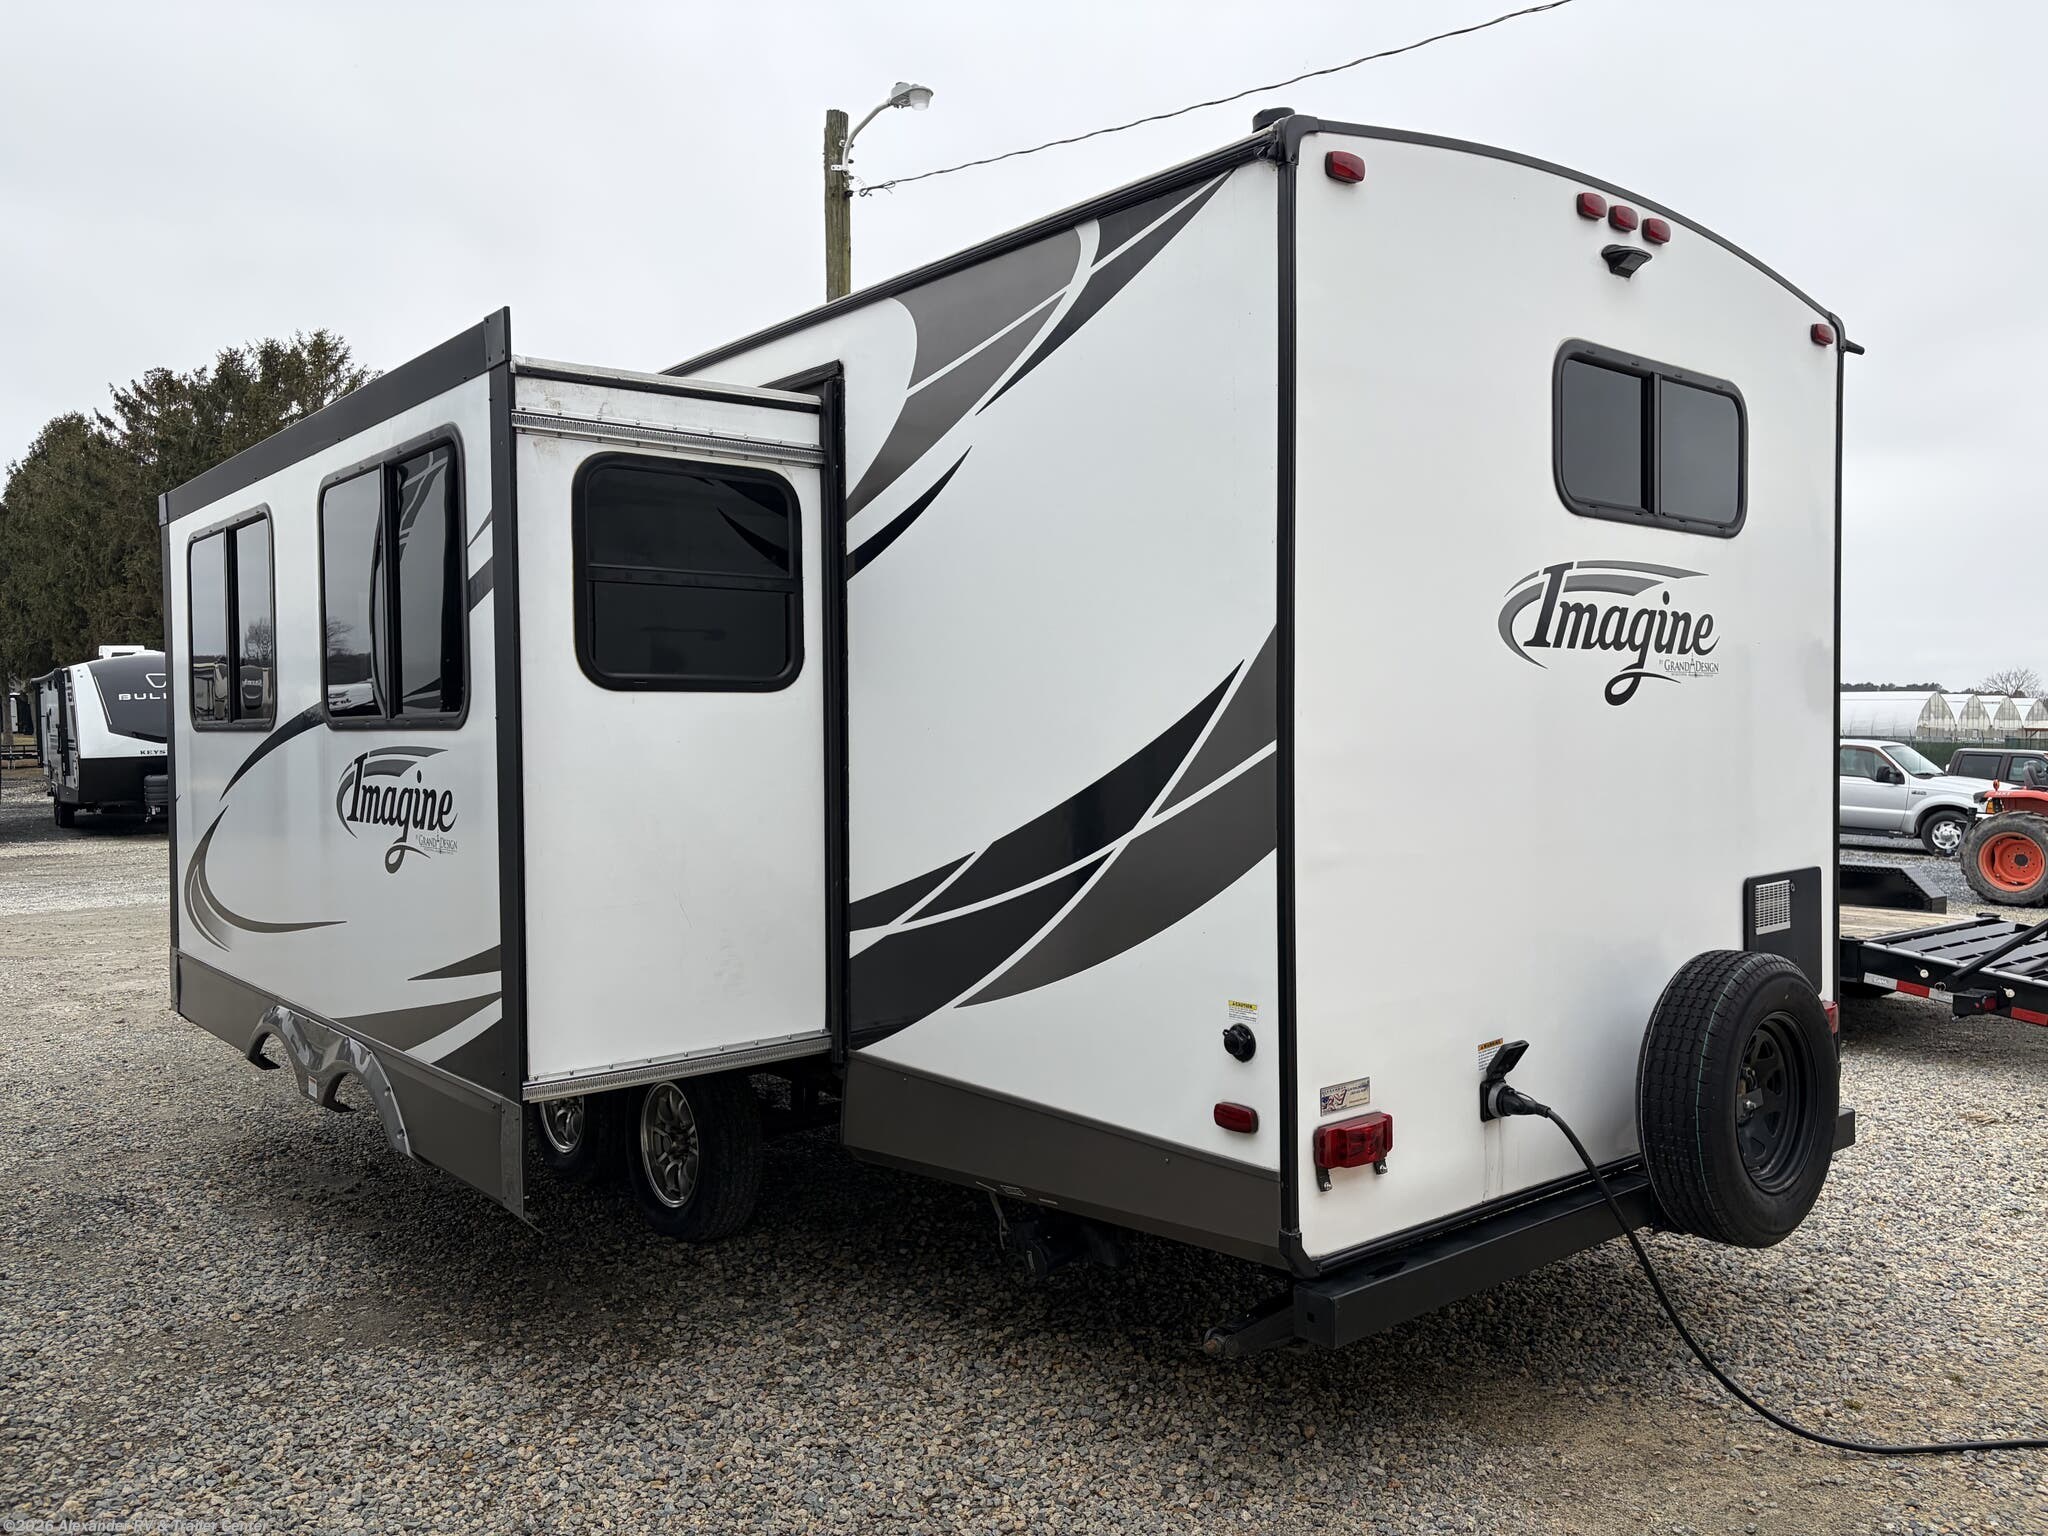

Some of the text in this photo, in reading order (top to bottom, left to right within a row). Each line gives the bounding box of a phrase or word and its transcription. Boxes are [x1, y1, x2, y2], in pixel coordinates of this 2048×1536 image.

[1523, 561, 1721, 706] Imagine
[1663, 659, 1690, 672] GRAND
[1695, 660, 1720, 673] DESIGN
[346, 752, 459, 874] Imagine
